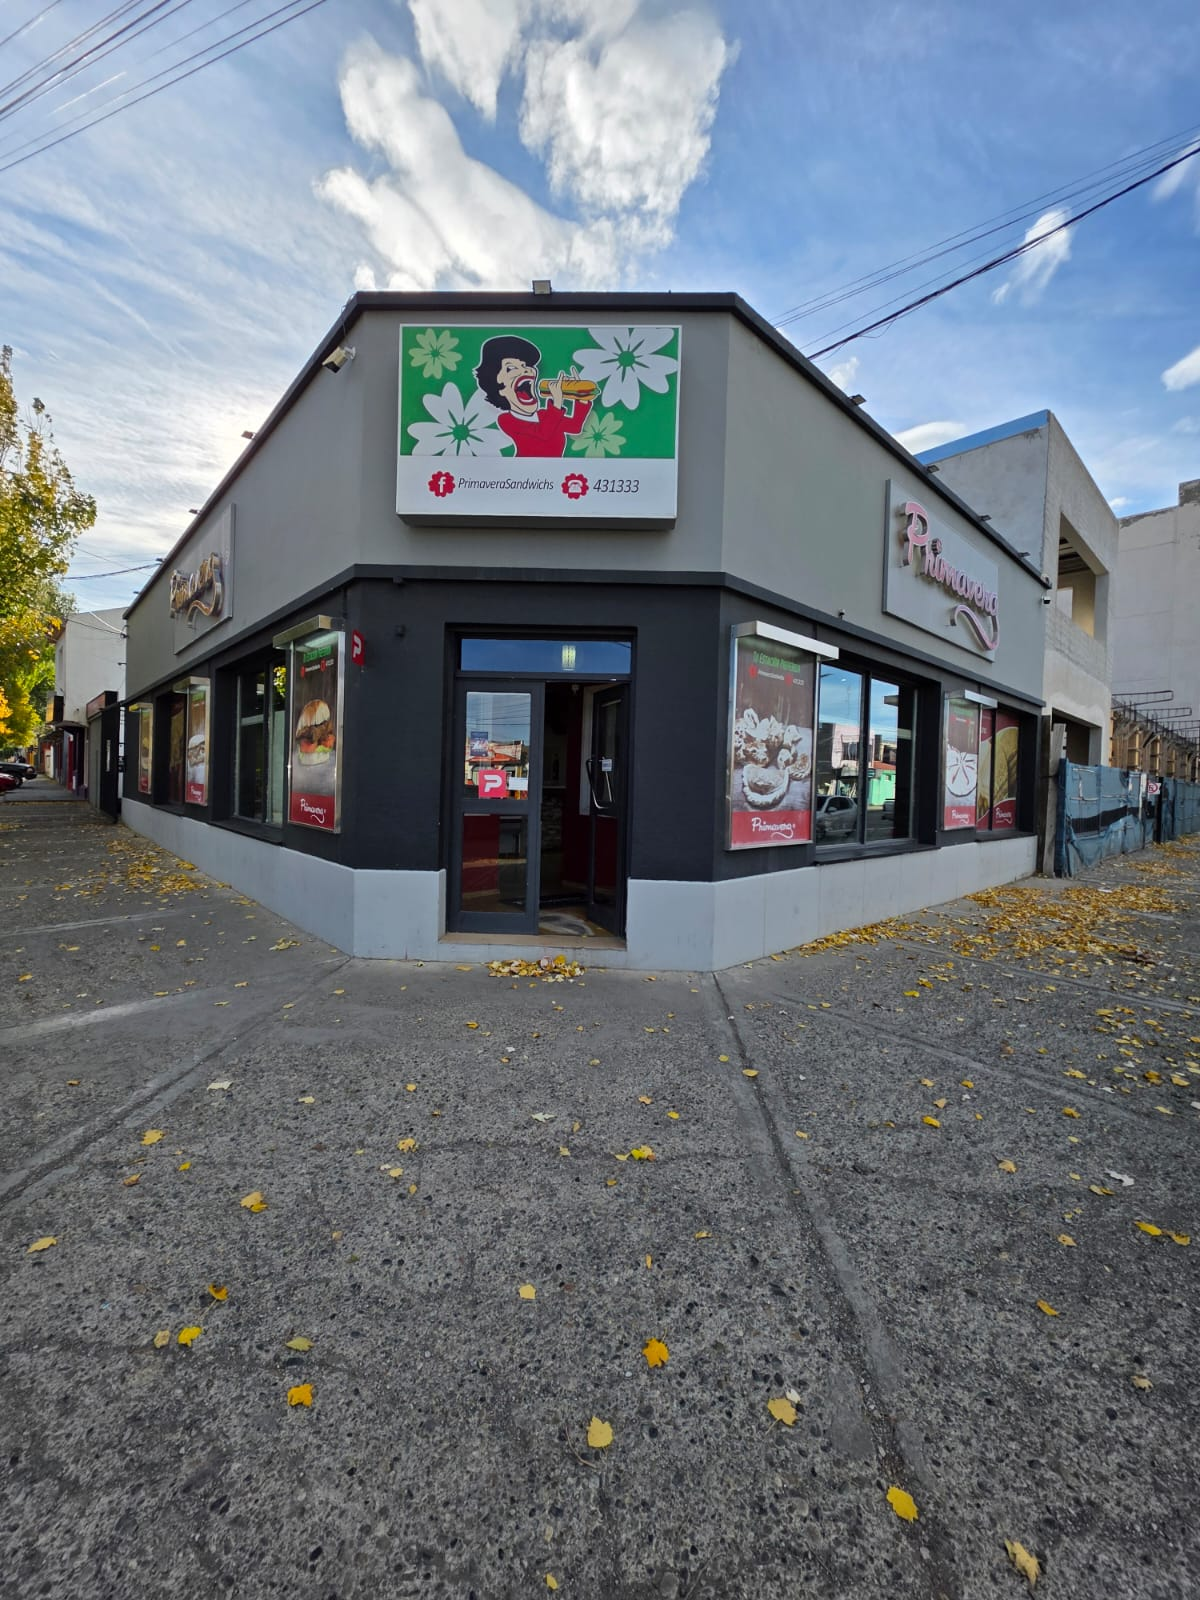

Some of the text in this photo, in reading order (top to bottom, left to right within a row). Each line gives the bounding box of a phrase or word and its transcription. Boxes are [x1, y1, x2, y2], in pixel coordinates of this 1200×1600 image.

[458, 477, 554, 490] PrimaveraSandwichs
[592, 479, 640, 493] 431333
[901, 501, 999, 651] Primavera
[483, 774, 503, 793] P
[751, 816, 795, 839] Primavera
